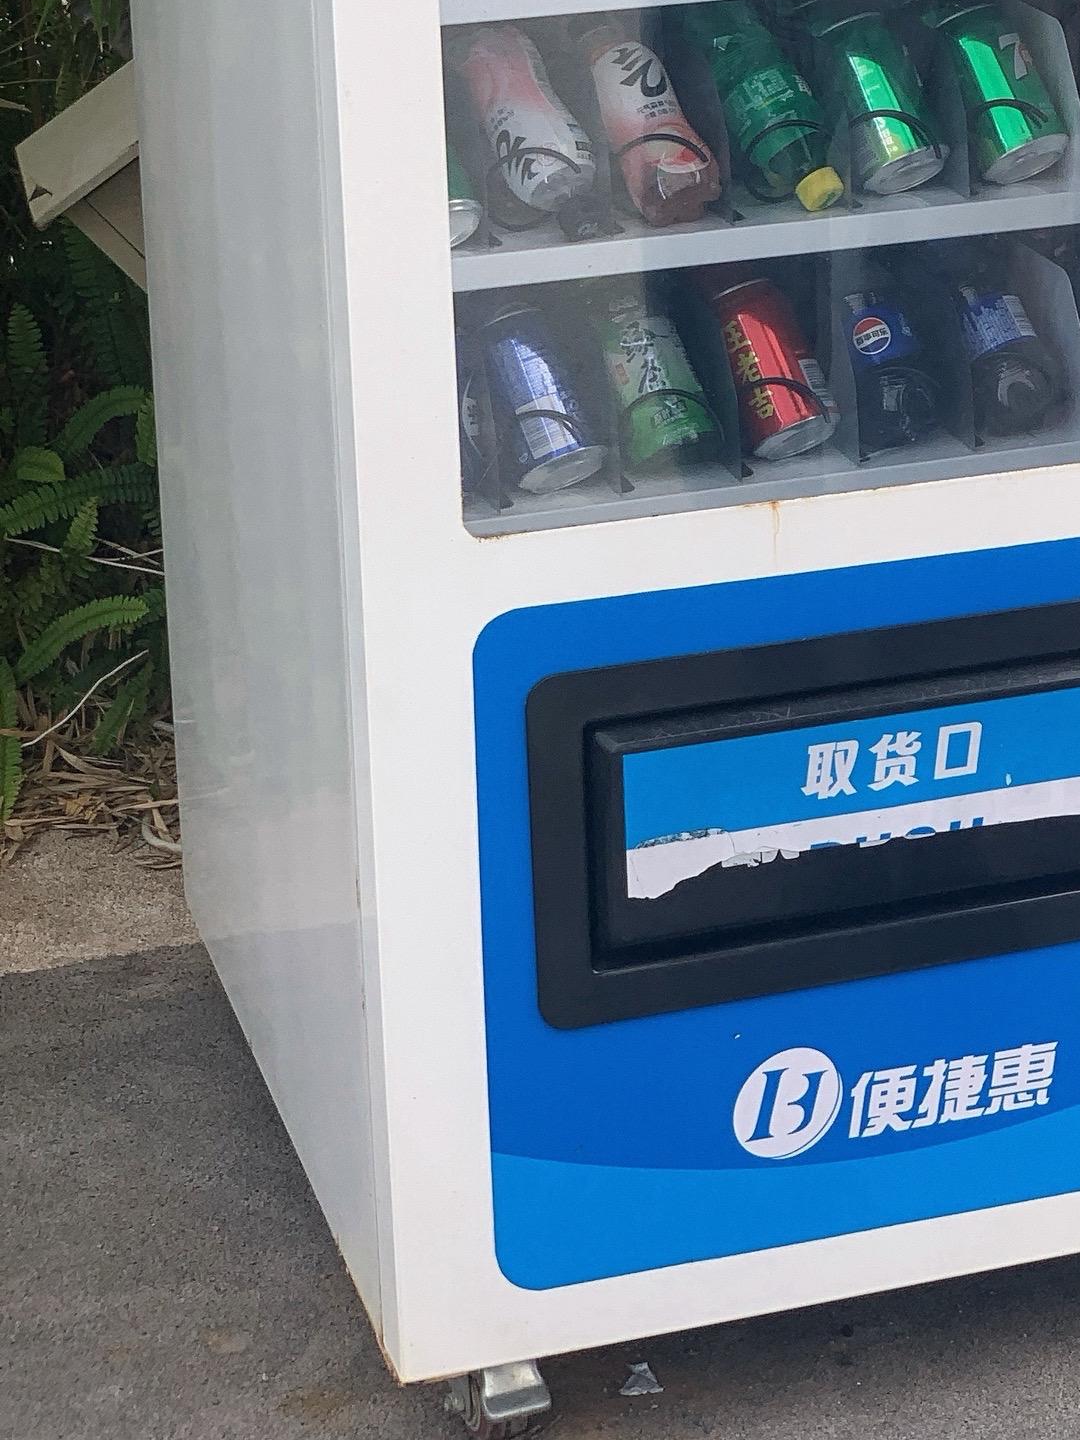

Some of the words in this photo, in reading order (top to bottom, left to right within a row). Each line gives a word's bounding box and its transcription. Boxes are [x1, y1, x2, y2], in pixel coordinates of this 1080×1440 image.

[725, 320, 775, 420] 王老吉
[801, 721, 984, 800] 取货口
[848, 1041, 1059, 1140] 便捷惠
